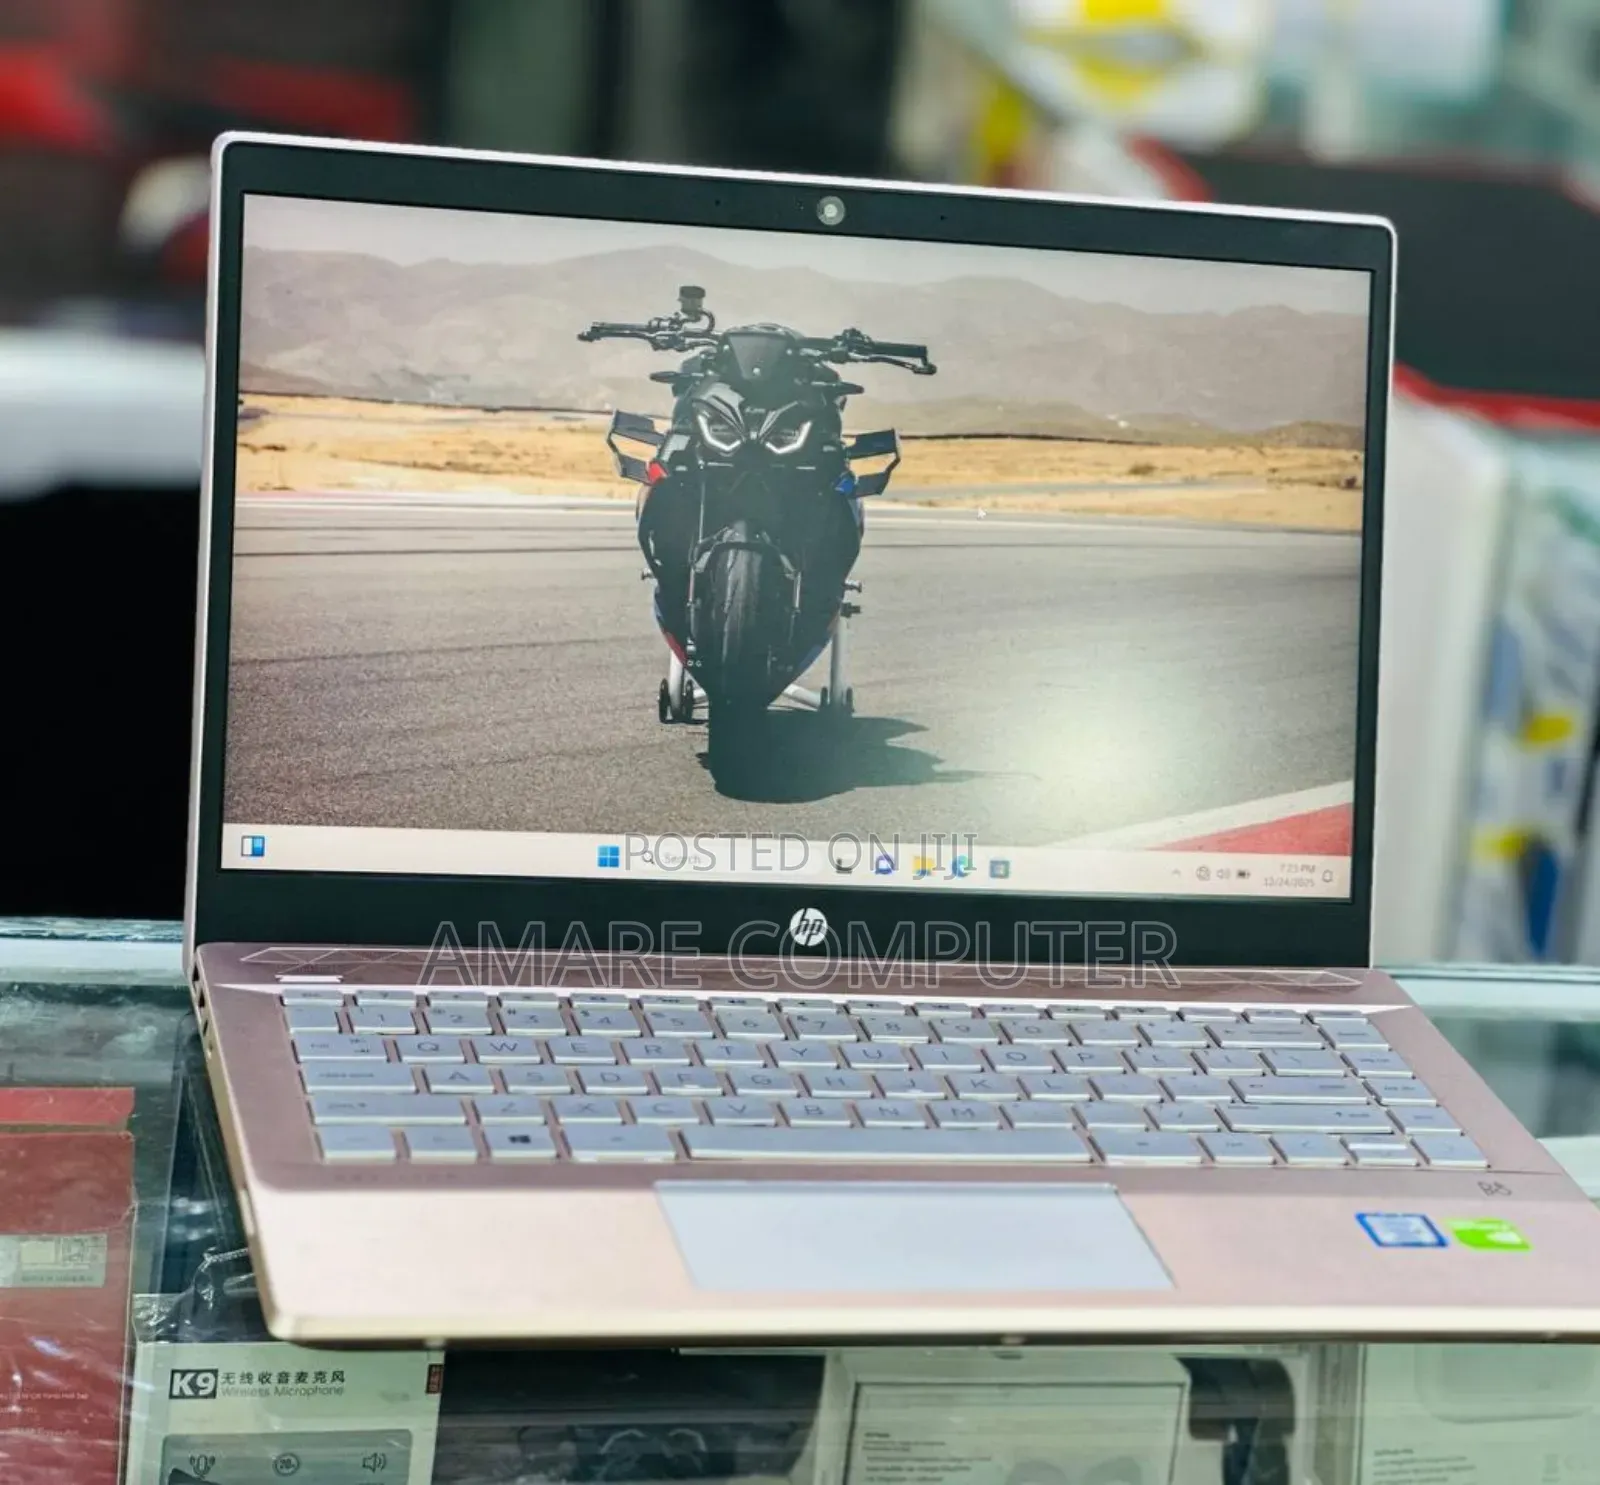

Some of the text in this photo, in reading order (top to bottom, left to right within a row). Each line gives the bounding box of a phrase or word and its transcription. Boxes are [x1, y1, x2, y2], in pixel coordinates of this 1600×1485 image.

[794, 908, 825, 947] hp
[417, 1041, 440, 1052] Q
[489, 1042, 519, 1051] W
[570, 1042, 588, 1054] E
[643, 1044, 663, 1055] R
[716, 1045, 735, 1056] T
[171, 1371, 217, 1397] K9
[220, 1370, 345, 1385] 无线收音麦克风
[221, 1385, 345, 1400] Wireless Microphone
